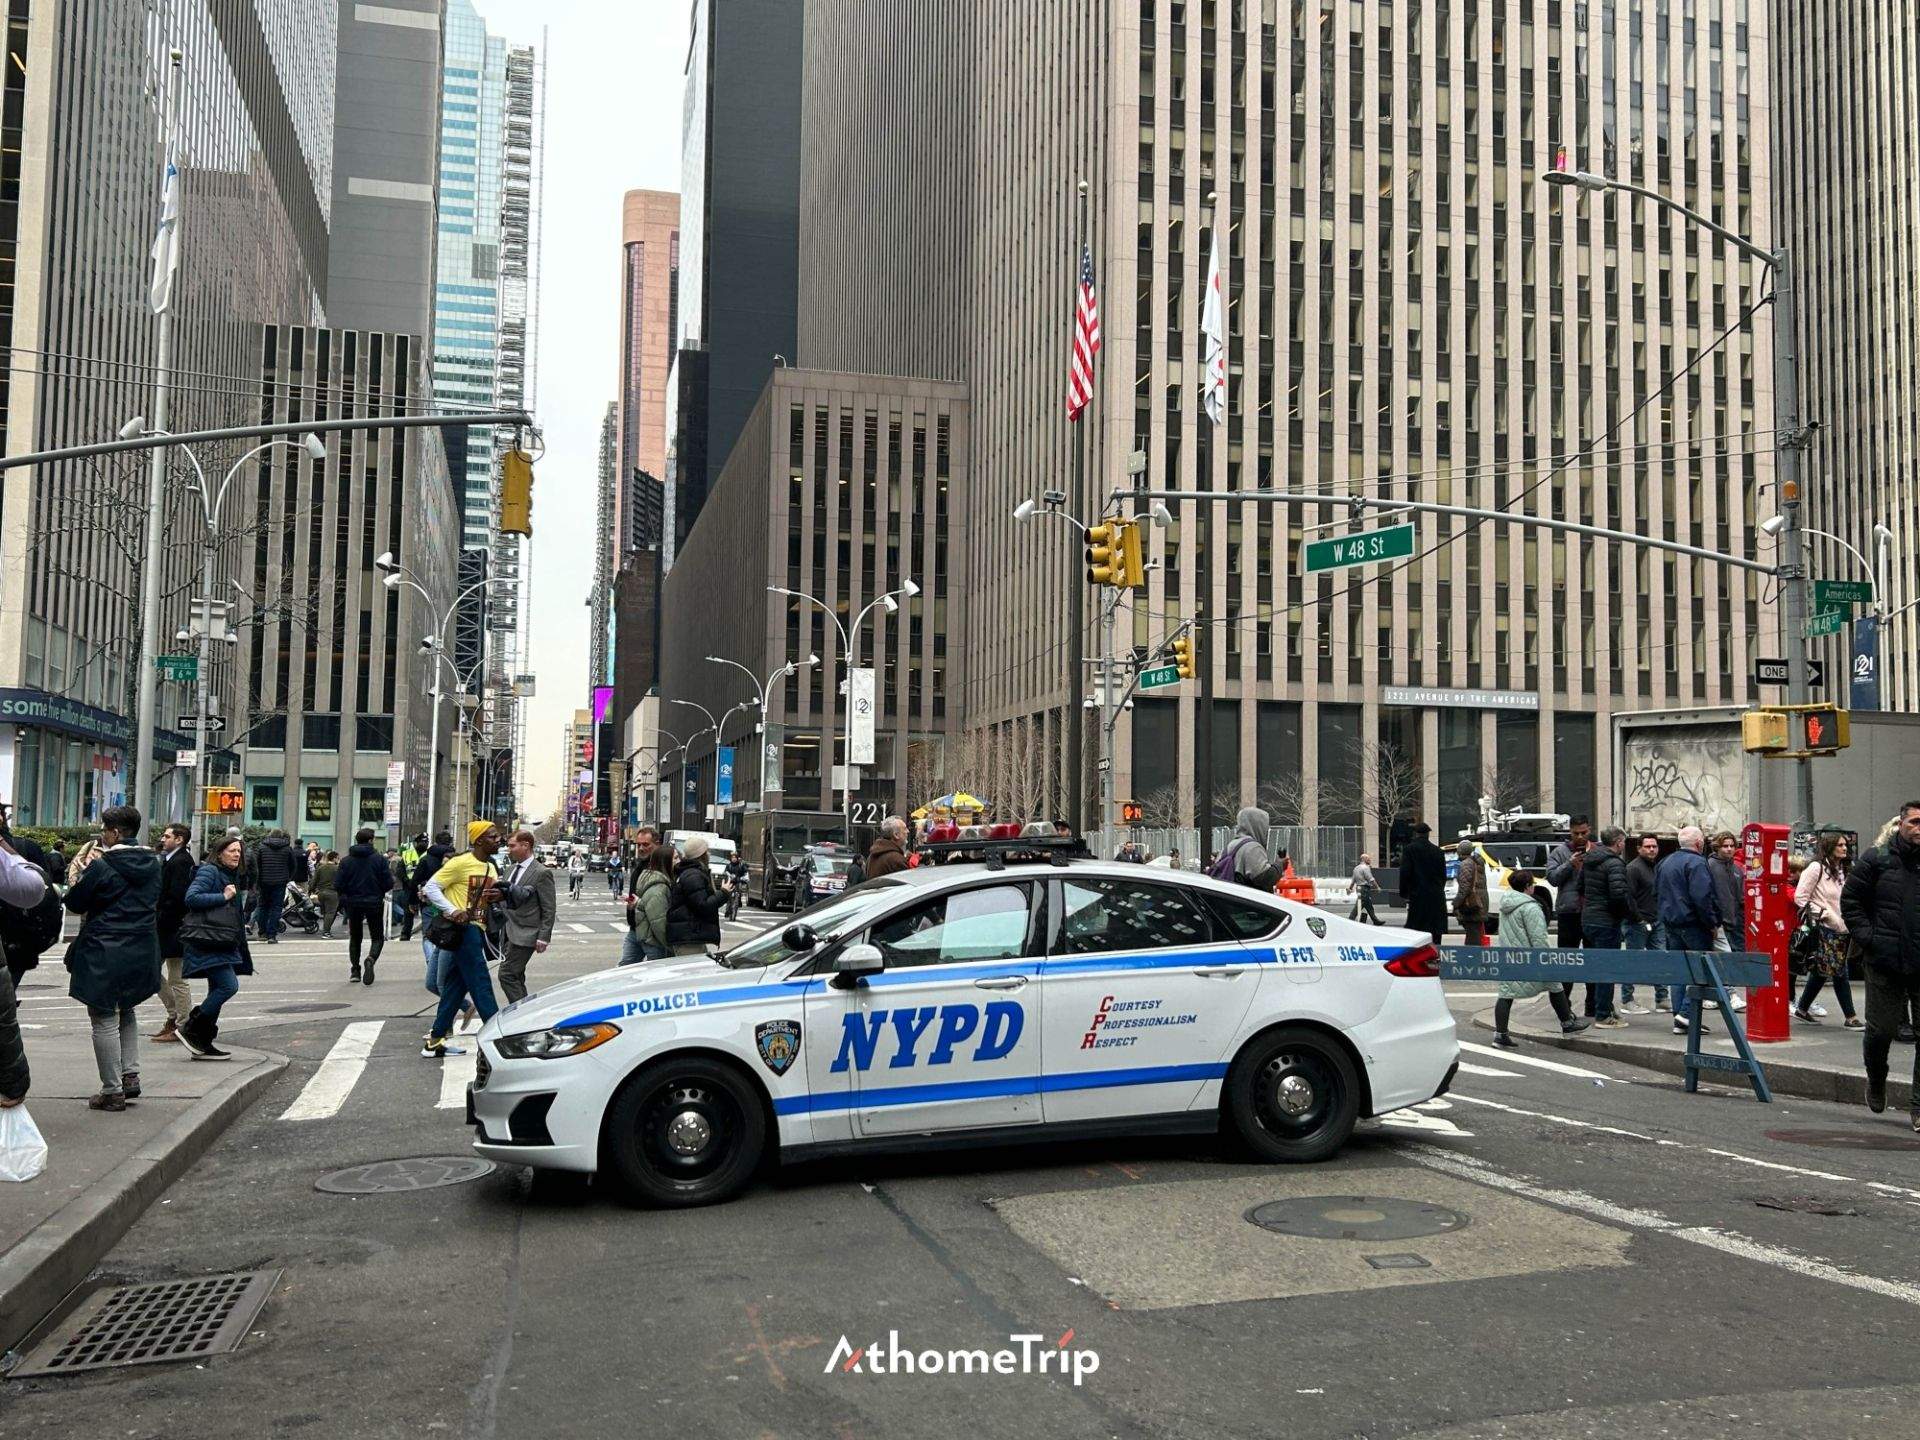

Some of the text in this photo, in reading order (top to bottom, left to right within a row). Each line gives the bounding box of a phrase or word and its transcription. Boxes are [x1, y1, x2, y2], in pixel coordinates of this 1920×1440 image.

[1333, 537, 1384, 562] W 48 St
[1825, 588, 1862, 600] Americas
[1813, 618, 1820, 634] W
[1820, 616, 1831, 632] 48
[178, 670, 184, 679] 6
[1150, 673, 1156, 684] W
[1156, 671, 1164, 683] 48
[1764, 666, 1784, 677] ONE
[1387, 691, 1537, 705] 1221 AVENUE OF THE AMERICAS
[1, 699, 47, 718] some
[1279, 947, 1288, 963] 6
[1290, 946, 1315, 962] PCT
[1482, 950, 1500, 964] DO
[1505, 951, 1533, 965] NOT
[1539, 951, 1585, 966] CROSS
[1452, 966, 1500, 976] NYPD
[626, 992, 696, 1016] POLICE
[1100, 995, 1163, 1013] COURTESY
[1090, 1013, 1198, 1031] PROFESSIONALISM
[829, 1000, 1025, 1073] NYPD
[1080, 1032, 1138, 1050] RESPECT
